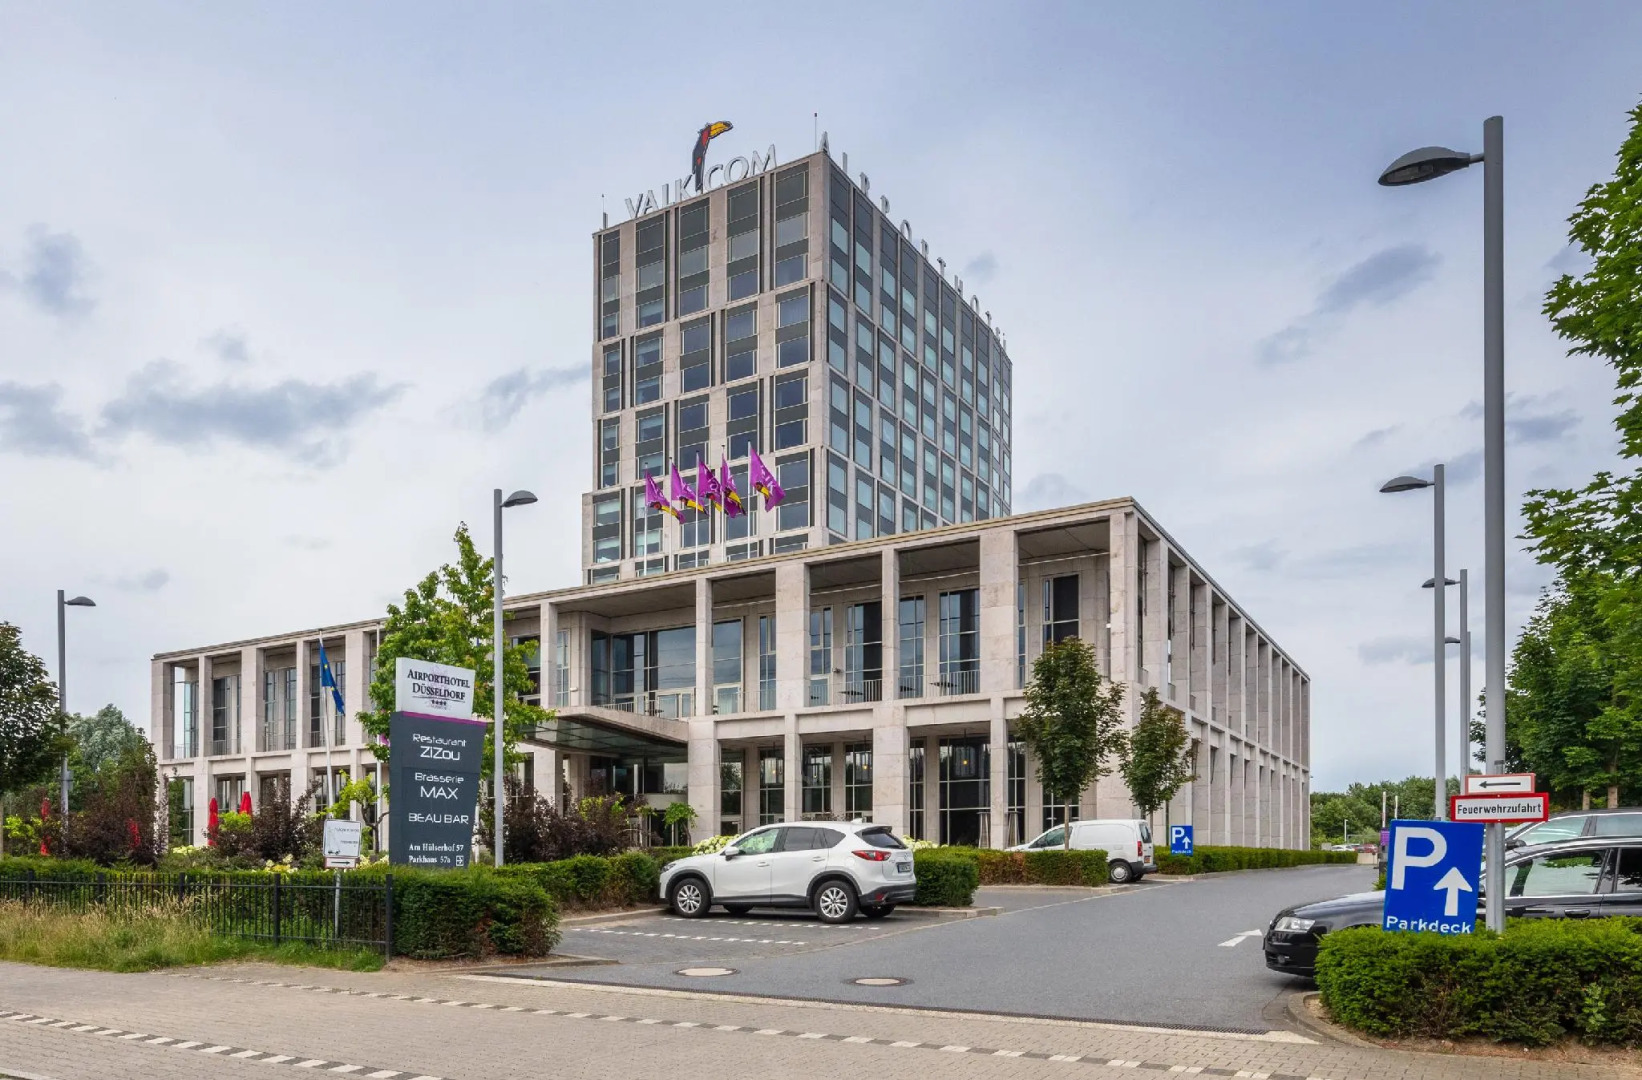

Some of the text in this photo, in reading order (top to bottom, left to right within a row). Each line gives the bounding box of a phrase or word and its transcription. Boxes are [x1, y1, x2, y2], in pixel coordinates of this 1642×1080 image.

[407, 669, 471, 688] AIRPORTHOTEL
[412, 682, 466, 700] DÜSSELDORF
[412, 733, 467, 747] Restaurant
[414, 772, 464, 783] Brasserie
[420, 785, 459, 800] MAX
[1457, 802, 1542, 815] Feuerwehrzufahrt
[408, 812, 469, 825] BEAU BAR
[1171, 826, 1185, 844] P
[456, 844, 464, 852] 57
[1391, 826, 1448, 891] P
[1386, 915, 1472, 934] Parkdeck
